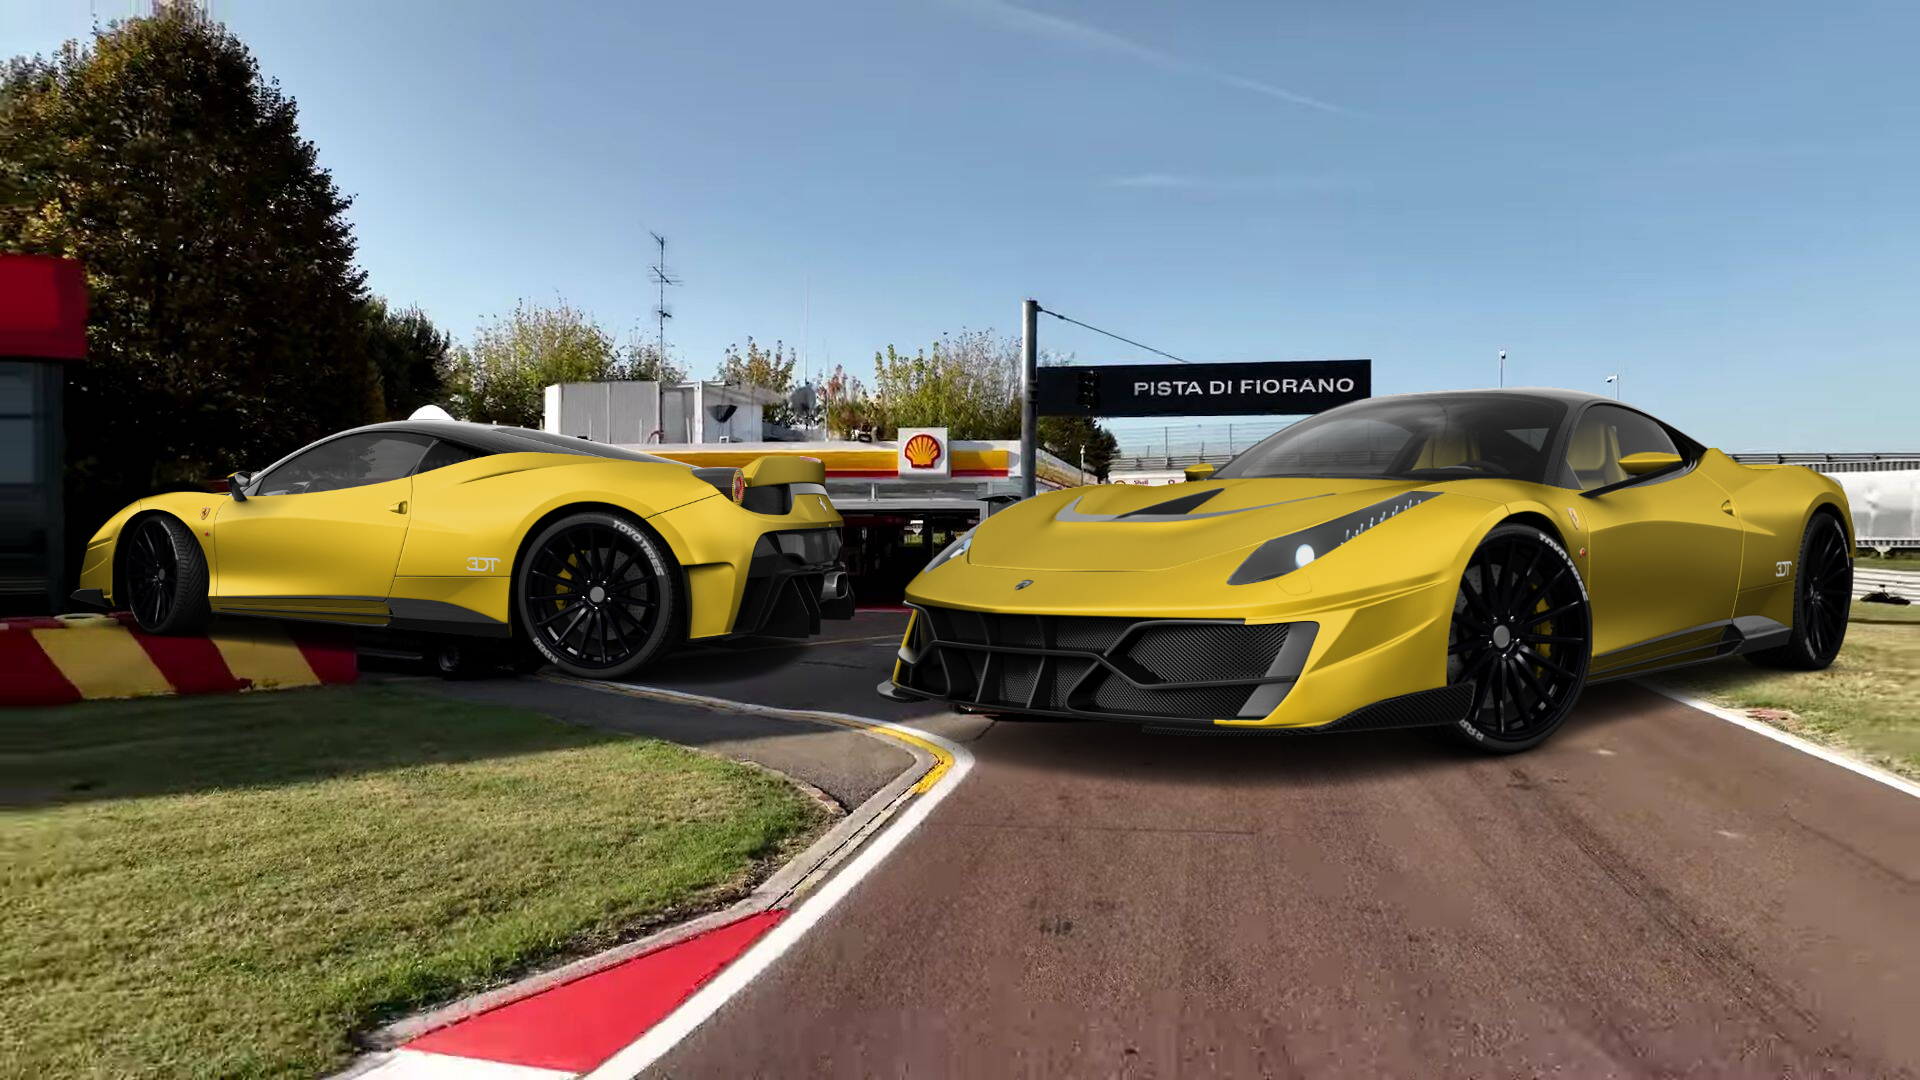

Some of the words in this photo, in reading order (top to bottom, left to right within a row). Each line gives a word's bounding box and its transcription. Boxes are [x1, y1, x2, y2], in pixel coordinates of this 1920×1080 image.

[1133, 381, 1203, 396] PISTA
[1209, 380, 1232, 394] DI
[1240, 378, 1354, 394] FIORANO
[613, 520, 642, 542] TOYO
[640, 540, 665, 576] TIRES
[1539, 533, 1568, 560] TOYO
[532, 637, 559, 664] R888
